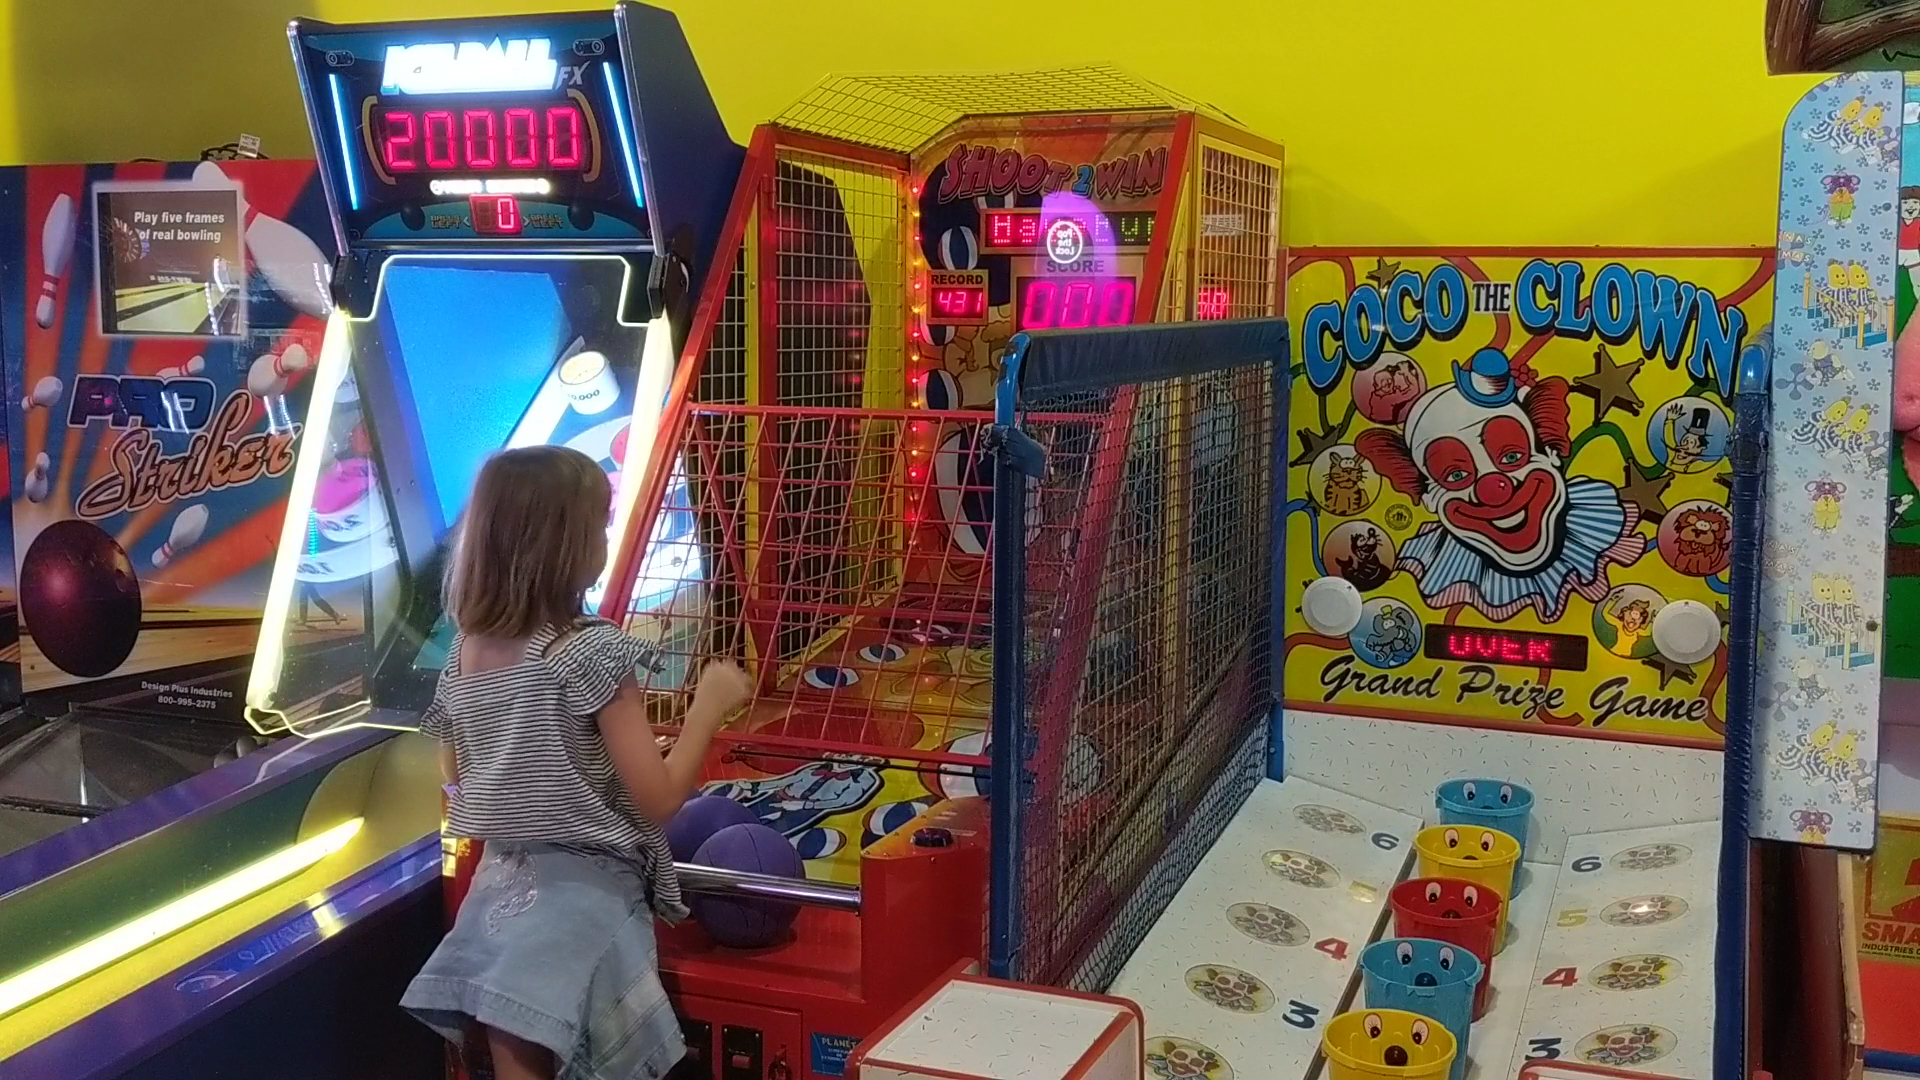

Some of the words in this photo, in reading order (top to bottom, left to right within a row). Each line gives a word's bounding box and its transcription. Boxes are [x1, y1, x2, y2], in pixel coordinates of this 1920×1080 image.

[556, 61, 590, 88] FX
[385, 107, 580, 168] 20000
[938, 144, 1073, 204] SHOOT
[1071, 164, 1095, 196] 2
[1095, 147, 1168, 199] WIN
[134, 211, 158, 226] Play
[161, 211, 182, 223] five
[185, 211, 225, 223] frames
[497, 198, 514, 229] 0
[140, 228, 151, 240] of
[153, 229, 174, 240] real
[177, 229, 221, 244] bowling
[1046, 260, 1104, 273] SCORE
[931, 274, 983, 285] RECORD
[939, 291, 983, 313] 431
[1303, 264, 1470, 393] COCO
[1473, 282, 1513, 314] THE
[1516, 258, 1746, 398] CLOWN
[68, 374, 216, 431] PRO
[76, 389, 301, 519] Striker
[141, 681, 169, 693] Design
[171, 684, 188, 694] Plus
[190, 686, 233, 698] Industries
[1319, 655, 1440, 703] Grand
[1453, 664, 1565, 719] Prize
[1589, 677, 1708, 727] Game
[158, 695, 216, 709] 800-995-2375
[1371, 830, 1400, 851] 6
[1571, 856, 1602, 873] 6
[1557, 908, 1588, 928] 5
[1314, 937, 1348, 961] 4
[1861, 943, 1914, 955] INDUSTRIES
[1541, 966, 1578, 988] 4
[1282, 1000, 1320, 1029] 3
[1525, 1037, 1561, 1060] 3
